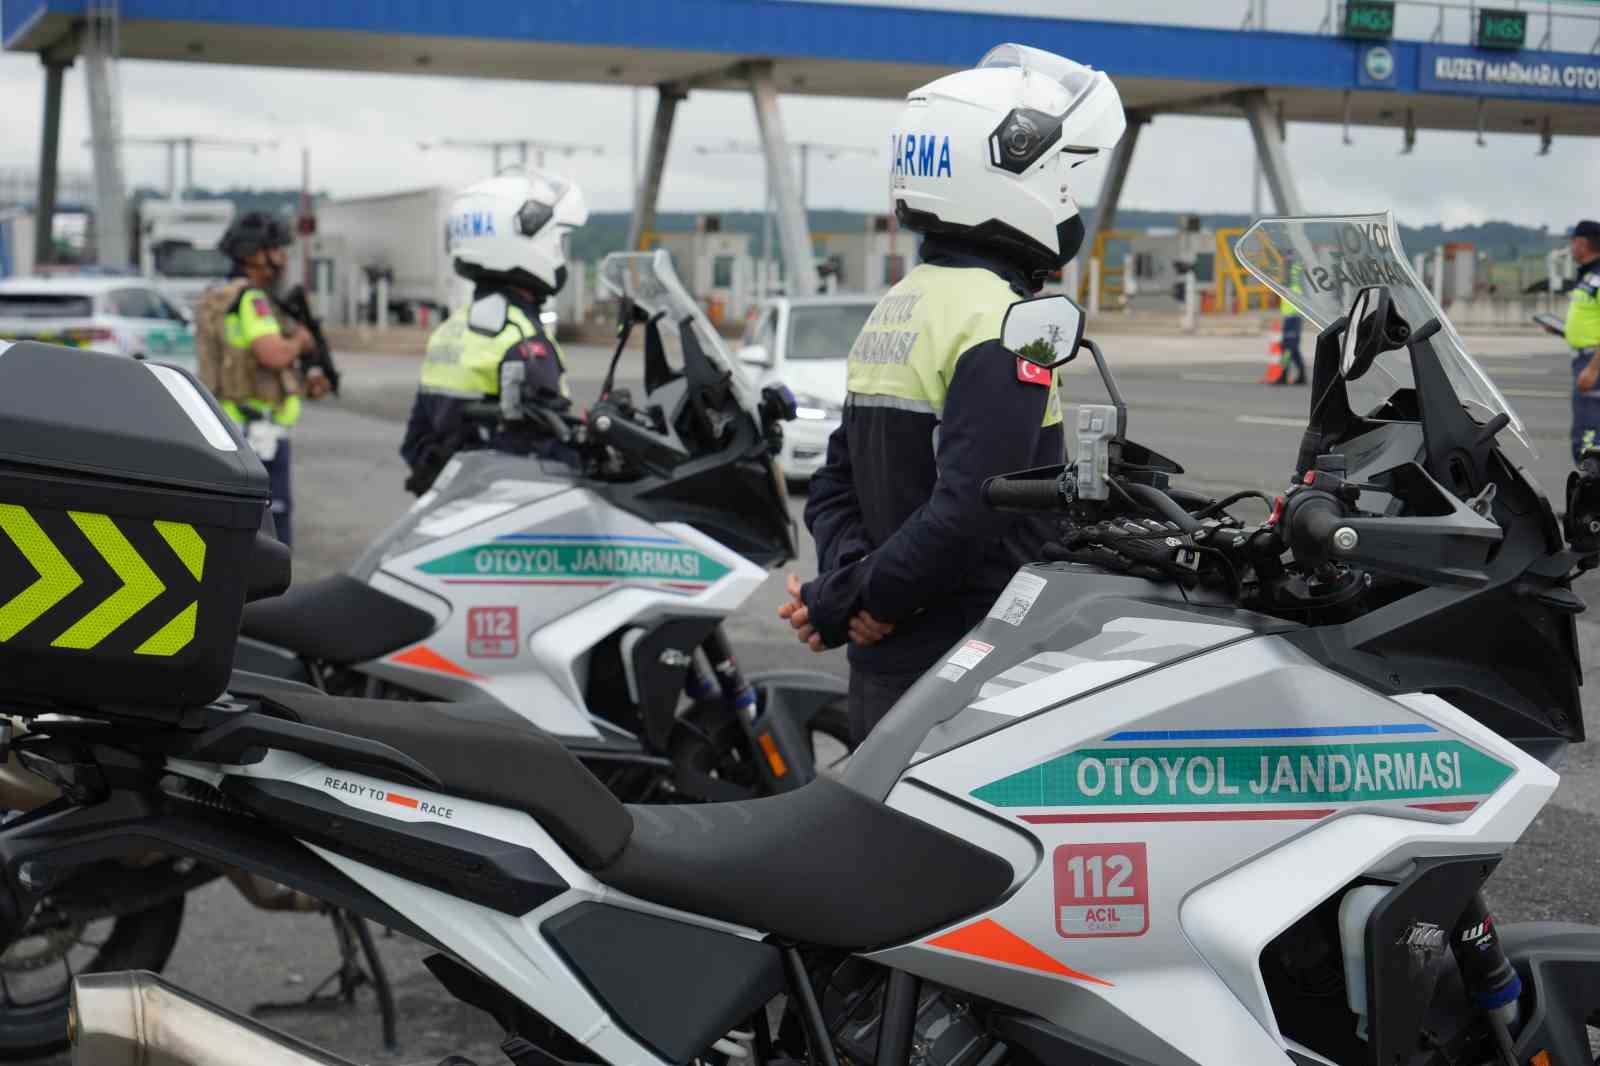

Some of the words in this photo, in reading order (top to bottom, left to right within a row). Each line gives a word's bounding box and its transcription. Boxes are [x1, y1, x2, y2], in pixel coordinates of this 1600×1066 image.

[1484, 18, 1523, 39] HGS
[1436, 56, 1484, 81] KUZEY
[1486, 61, 1561, 86] MARMARA
[1563, 66, 1600, 89] OTO
[474, 549, 566, 574] OTOYOL
[571, 548, 700, 577] JANDARMASI
[474, 611, 513, 637] 112
[1077, 756, 1240, 797] OTOYOL
[1249, 751, 1462, 795] JANDARMASI
[324, 777, 367, 796] READY
[369, 789, 385, 801] TO
[420, 801, 455, 819] RACE
[1067, 854, 1136, 898] 112
